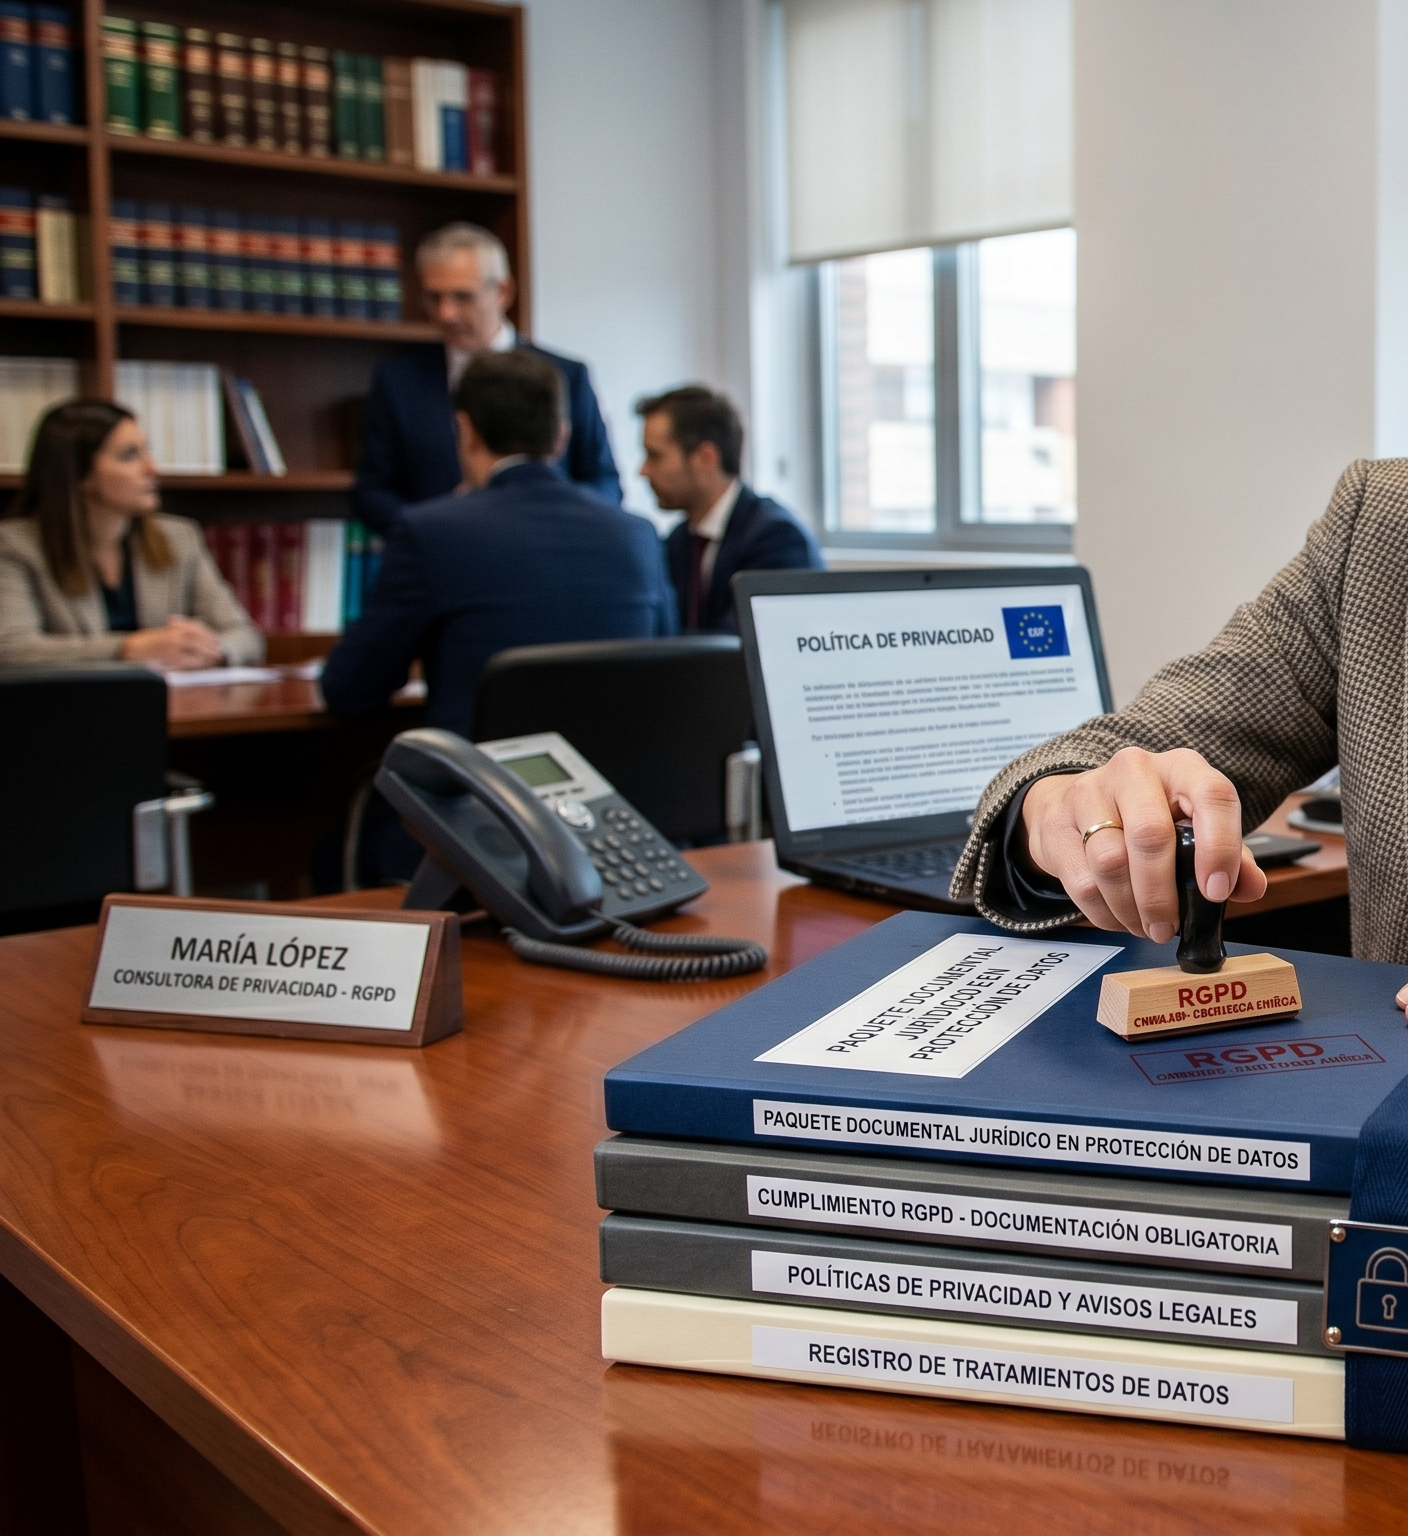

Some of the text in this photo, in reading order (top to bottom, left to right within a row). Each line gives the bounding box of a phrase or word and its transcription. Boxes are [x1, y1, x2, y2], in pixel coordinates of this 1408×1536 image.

[797, 627, 995, 653] POLÍTICA DE PRIVACIDAD
[170, 933, 348, 971] MARÍA LÓPEZ
[113, 968, 214, 990] CONSULTORA
[218, 975, 239, 992] DE
[242, 977, 337, 999] PRIVACIDAD
[351, 985, 396, 1002] RGPD
[825, 945, 1004, 1053] PAQUETE DOCUMENTAL
[908, 951, 1070, 1061] PROTECCIÓN DE DATOS
[1177, 980, 1248, 1009] RGPD
[1184, 1042, 1325, 1069] RGPD
[763, 1109, 1299, 1169] PAQUETE DOCUMENTAL JURÍDICO EN PROTECCIÓN DE DATOS
[757, 1187, 896, 1218] CUMPLIMIENTO
[901, 1202, 954, 1224] RGPD
[970, 1208, 1139, 1242] DOCUMENTACIÓN
[1145, 1225, 1280, 1256] OBLIGATORIA
[787, 1264, 1257, 1329] POLÍTICAS DE PRIVACIDAD Y AVISOS LEGALES
[808, 1342, 1230, 1406] REGISTRO DE TRATAMIENTOS DE DATOS
